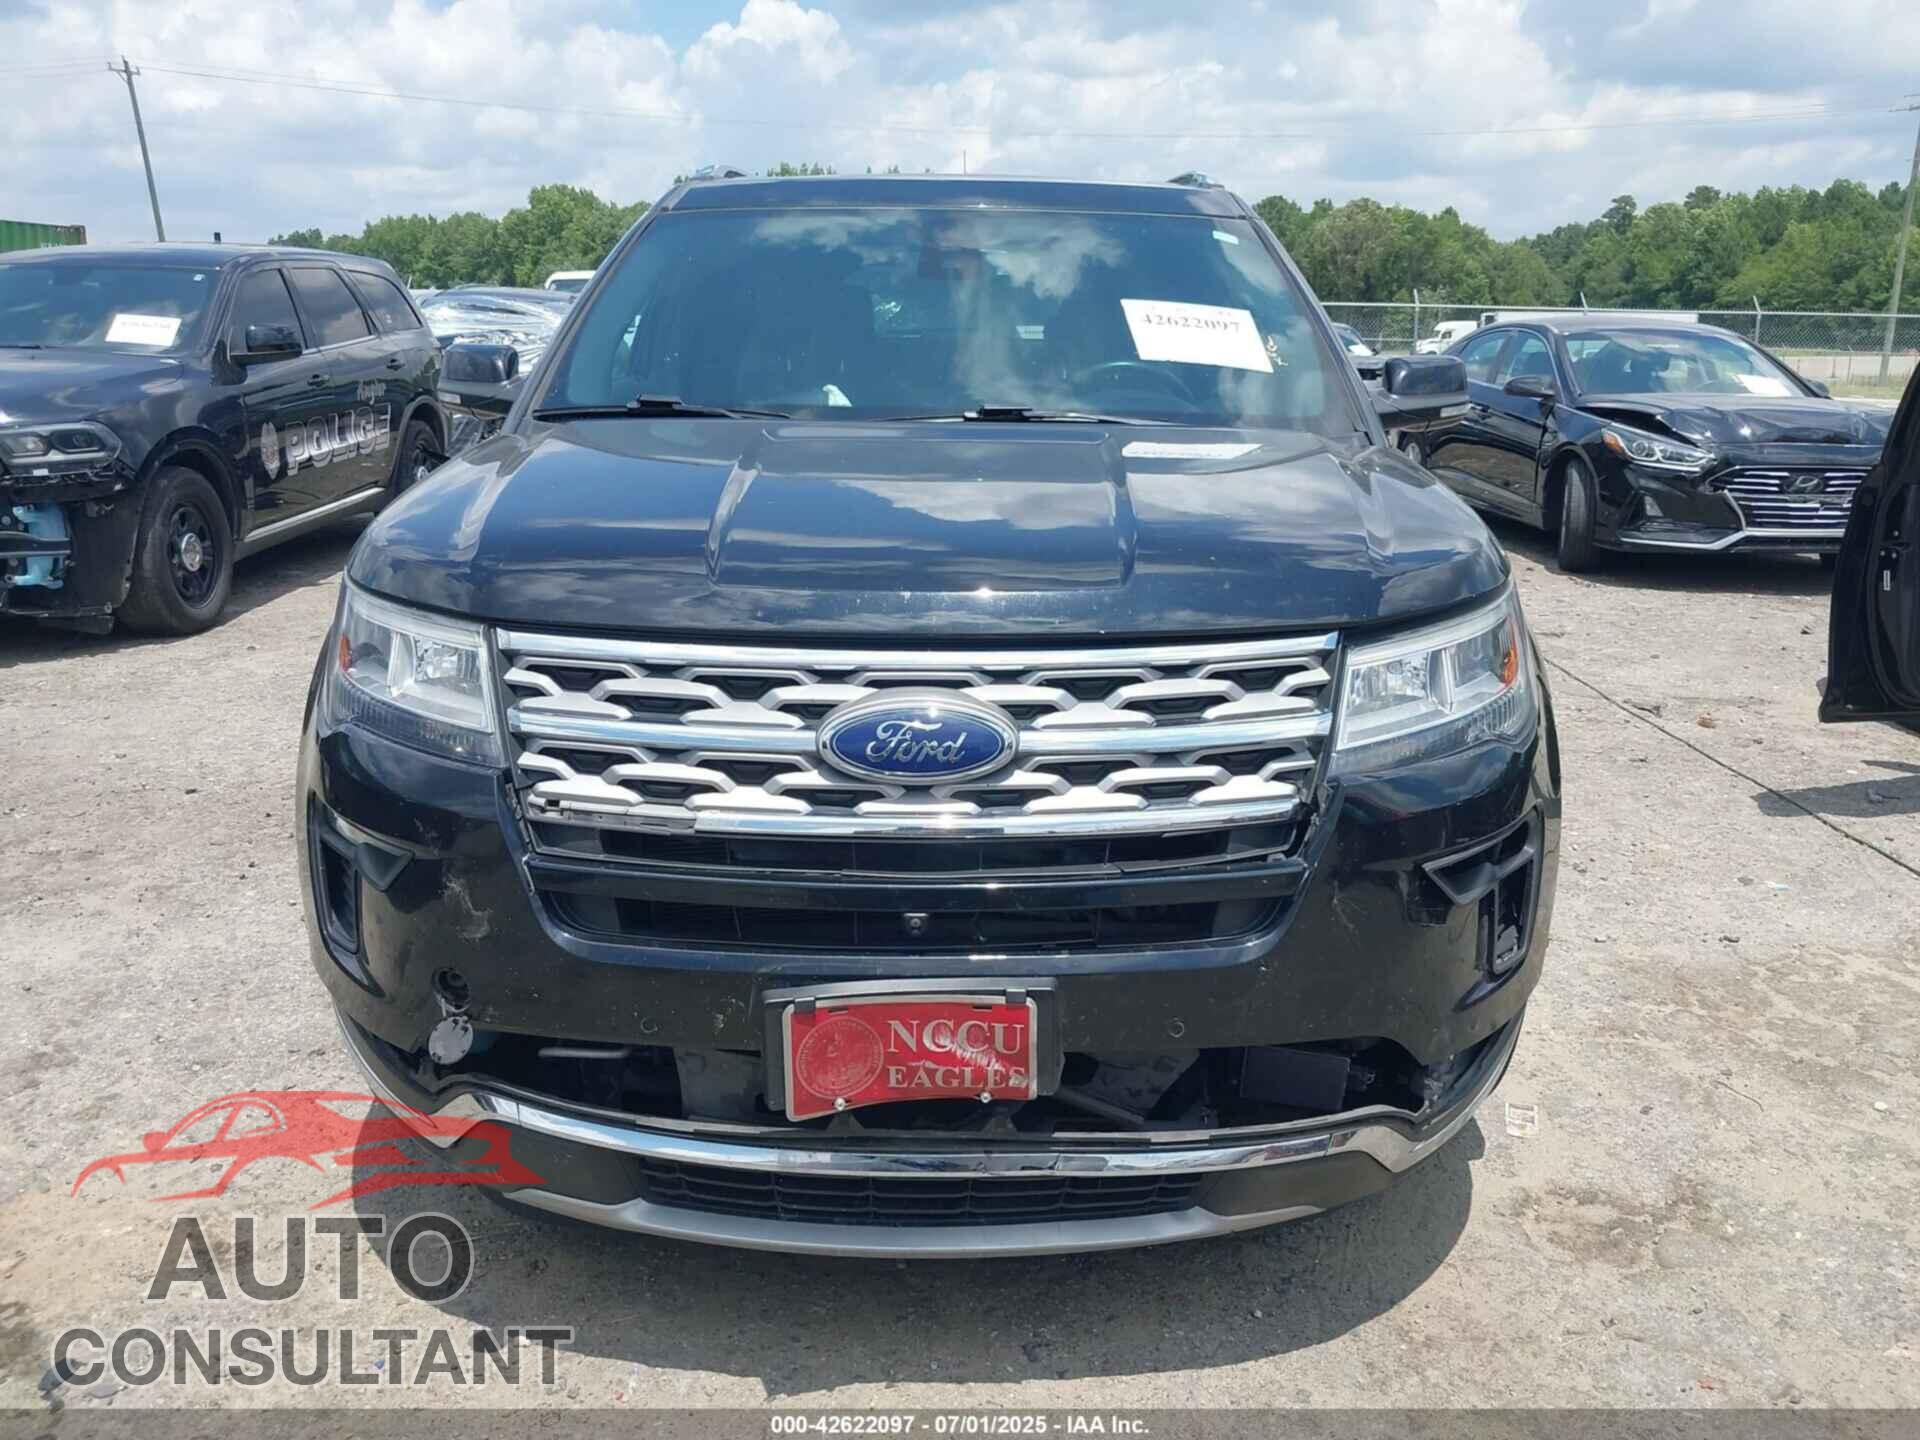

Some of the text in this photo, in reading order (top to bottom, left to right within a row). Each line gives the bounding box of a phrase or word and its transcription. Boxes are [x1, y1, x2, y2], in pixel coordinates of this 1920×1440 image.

[1142, 314, 1240, 333] 42622097
[286, 402, 391, 476] POLICE
[866, 720, 968, 764] Ford
[887, 1018, 1025, 1055] NCCU
[887, 1066, 1027, 1089] EAGLES
